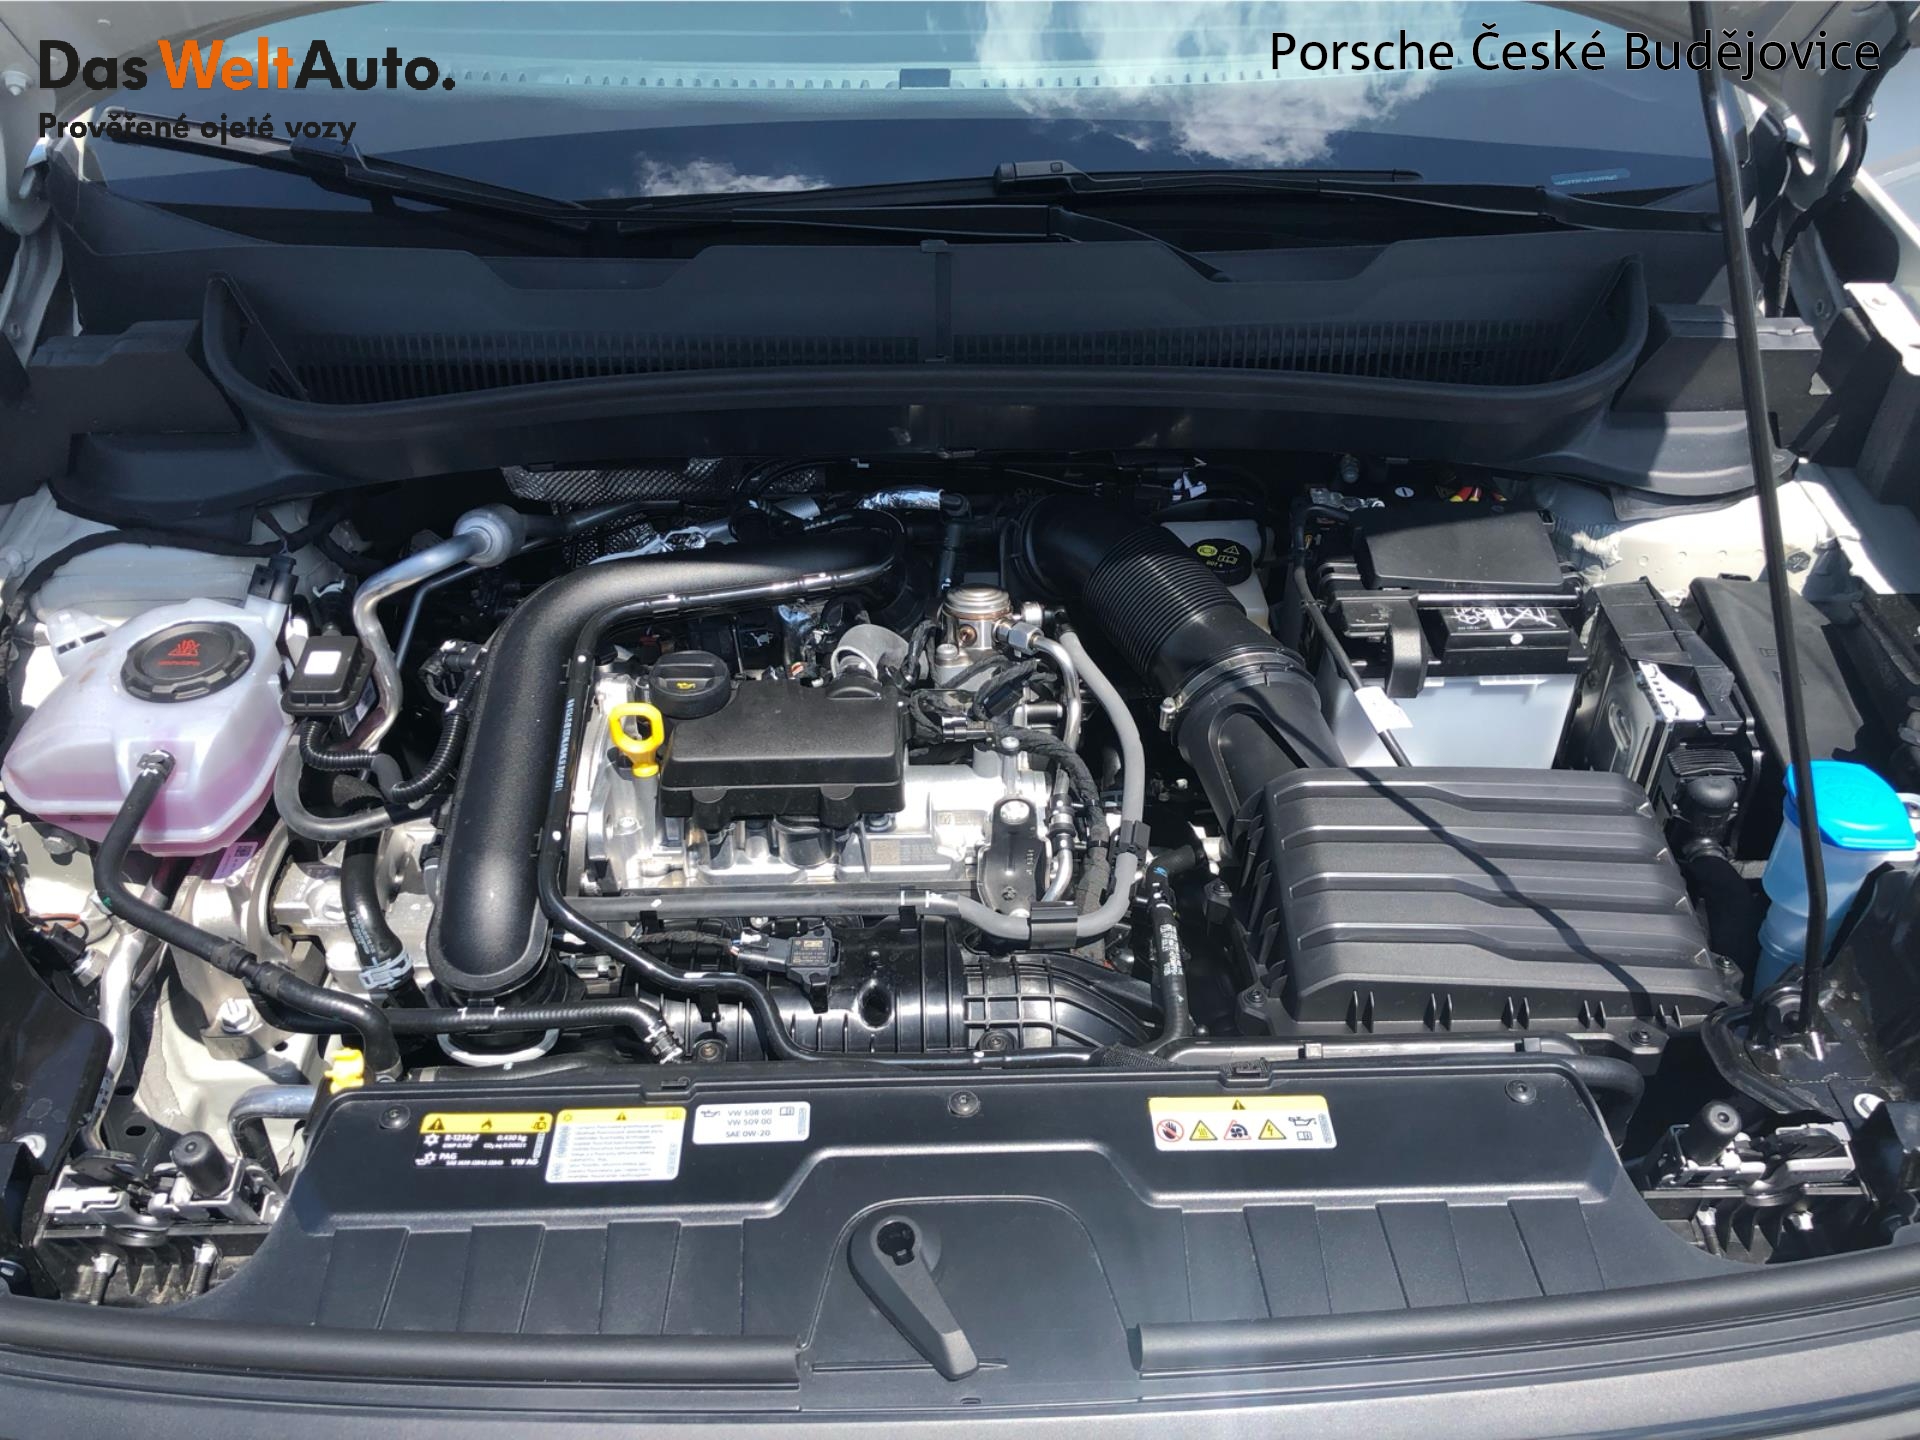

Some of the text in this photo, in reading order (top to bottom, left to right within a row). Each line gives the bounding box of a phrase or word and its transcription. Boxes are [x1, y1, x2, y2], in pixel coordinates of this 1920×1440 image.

[727, 1109, 742, 1117] VW
[761, 1108, 773, 1116] 00
[438, 1152, 458, 1160] PAG
[510, 1158, 525, 1166] VW
[525, 1158, 539, 1166] AG
